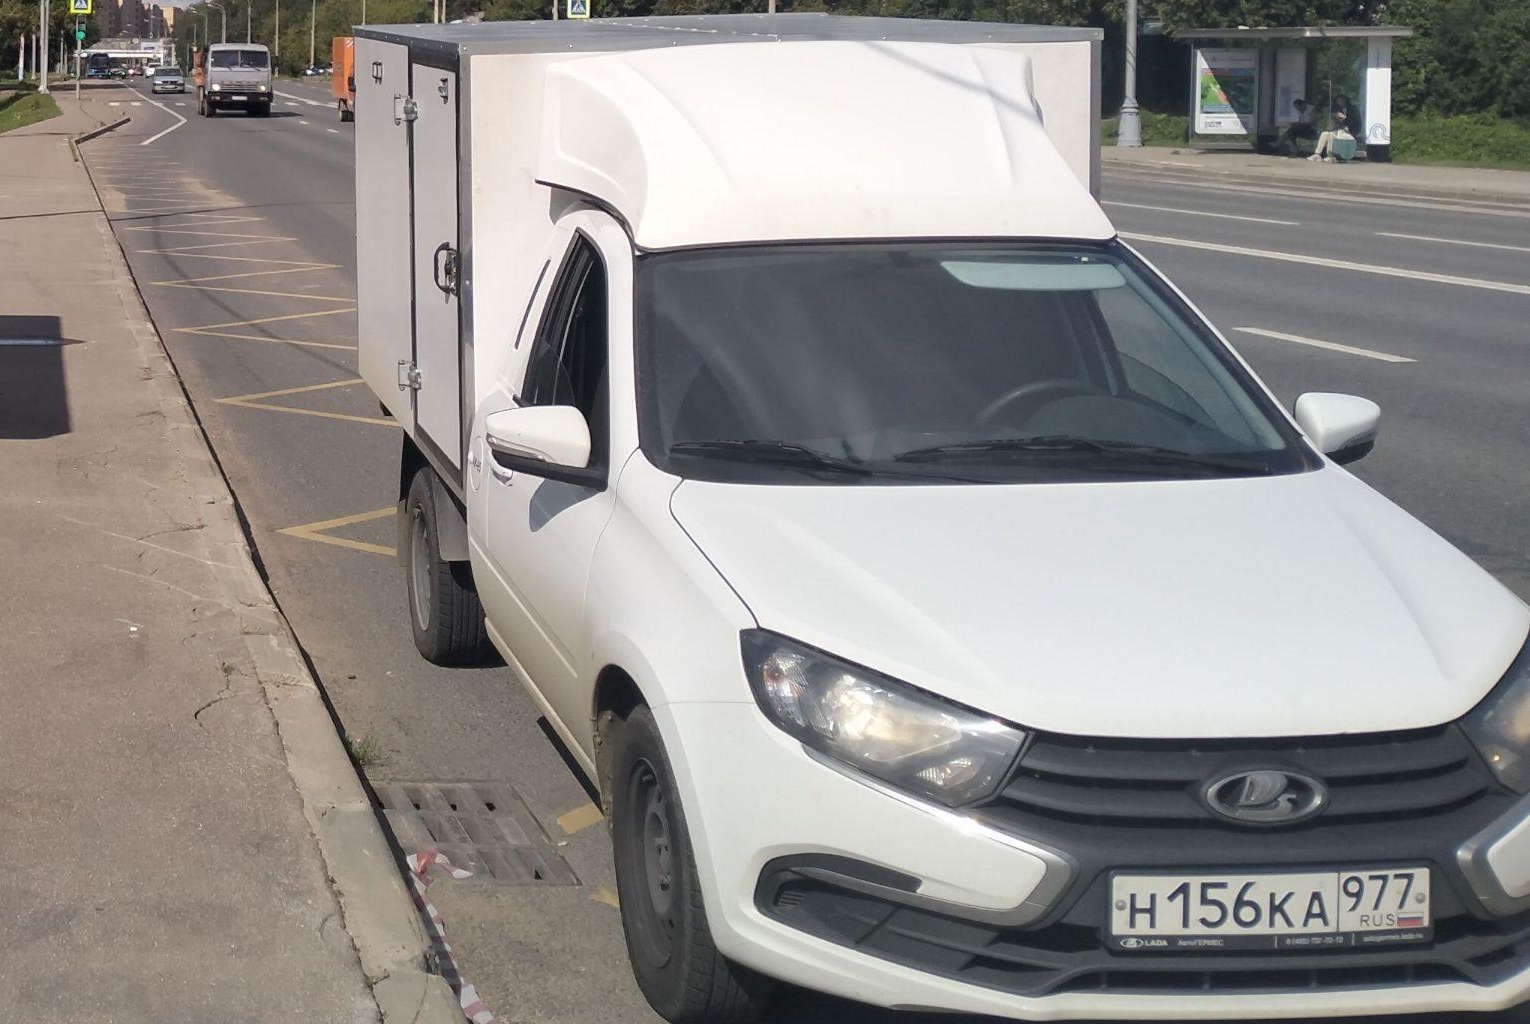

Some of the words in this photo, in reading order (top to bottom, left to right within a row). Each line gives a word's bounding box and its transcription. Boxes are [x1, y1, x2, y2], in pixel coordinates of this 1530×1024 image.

[1342, 872, 1415, 912] 977
[1359, 913, 1396, 927] RUS
[1144, 938, 1168, 947] LADA
